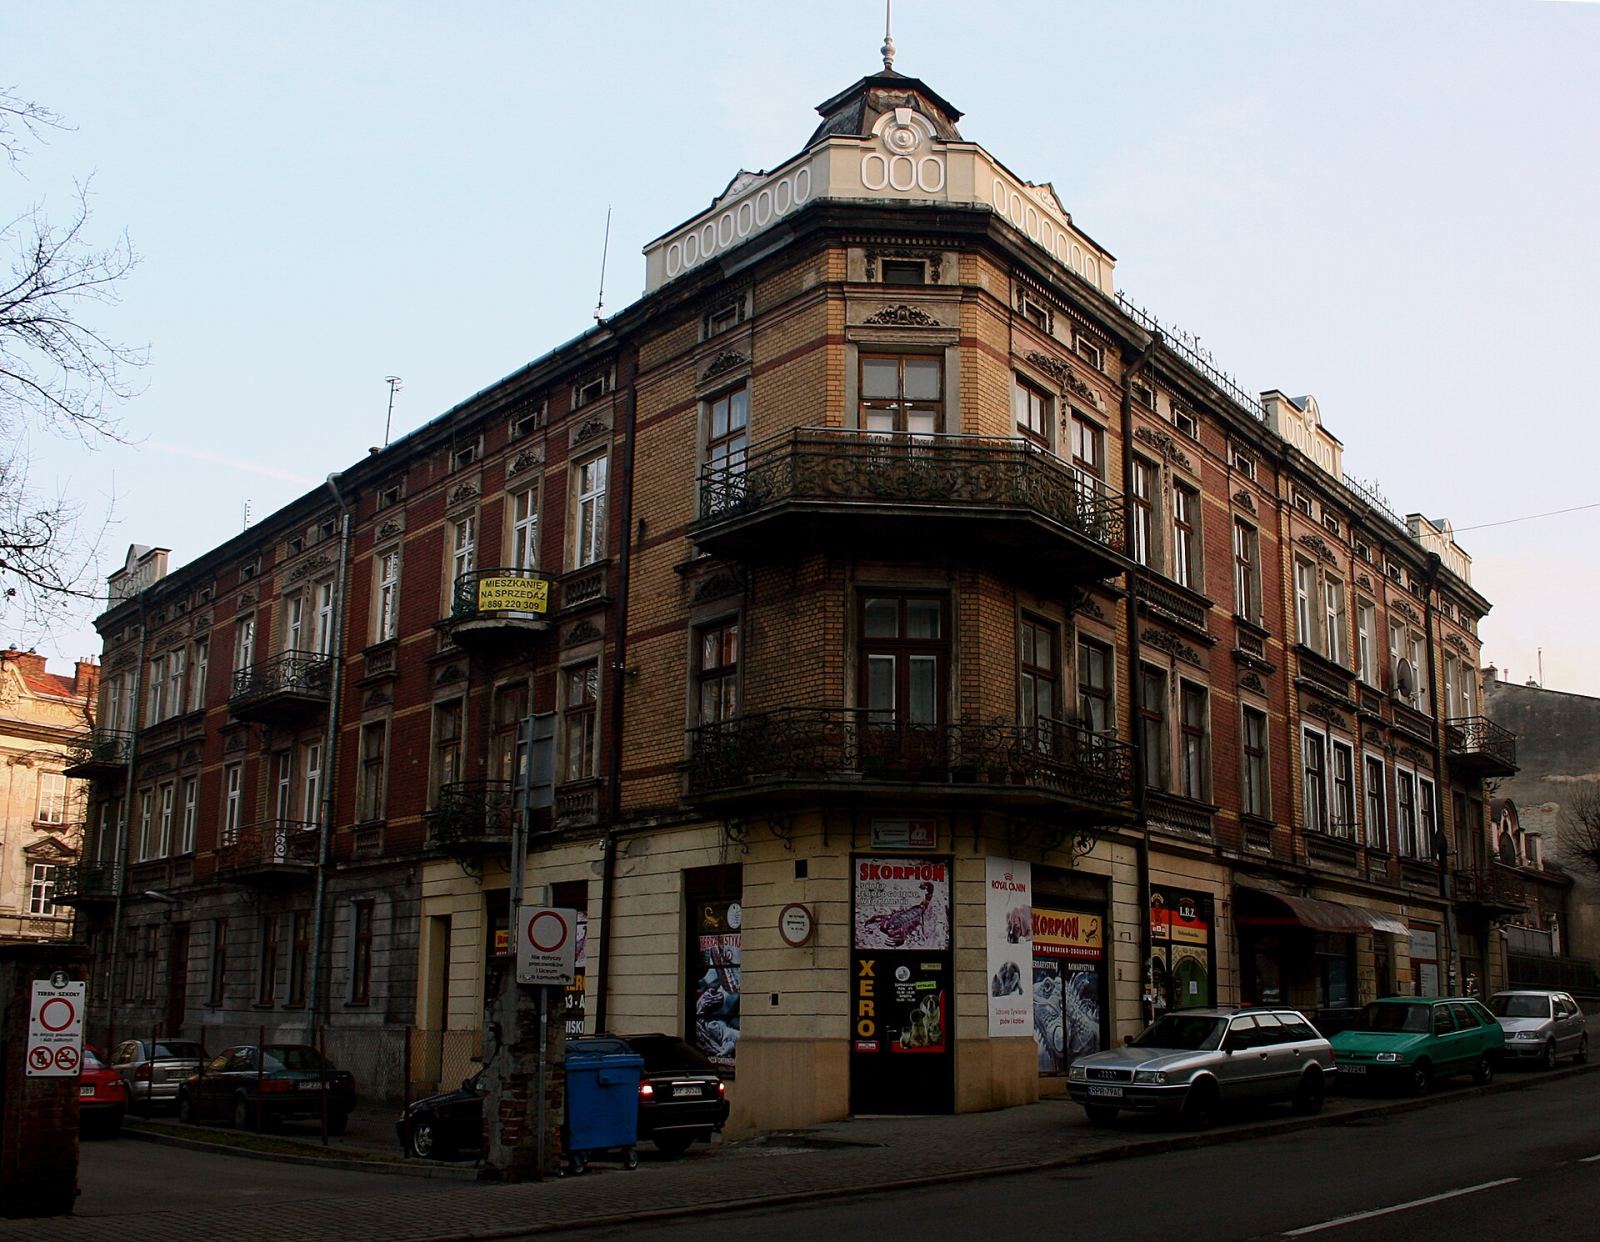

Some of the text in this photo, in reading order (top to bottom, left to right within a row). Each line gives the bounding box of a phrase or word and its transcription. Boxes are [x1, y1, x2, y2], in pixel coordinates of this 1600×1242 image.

[485, 579, 543, 589] MIESZKANIE
[480, 590, 493, 598] NA
[505, 600, 521, 608] 220
[523, 601, 539, 610] 309
[860, 862, 945, 882] SKORPION
[991, 880, 1026, 893] ROYAL CANIN
[1032, 913, 1079, 941] KORPION
[857, 959, 876, 1037] XERO
